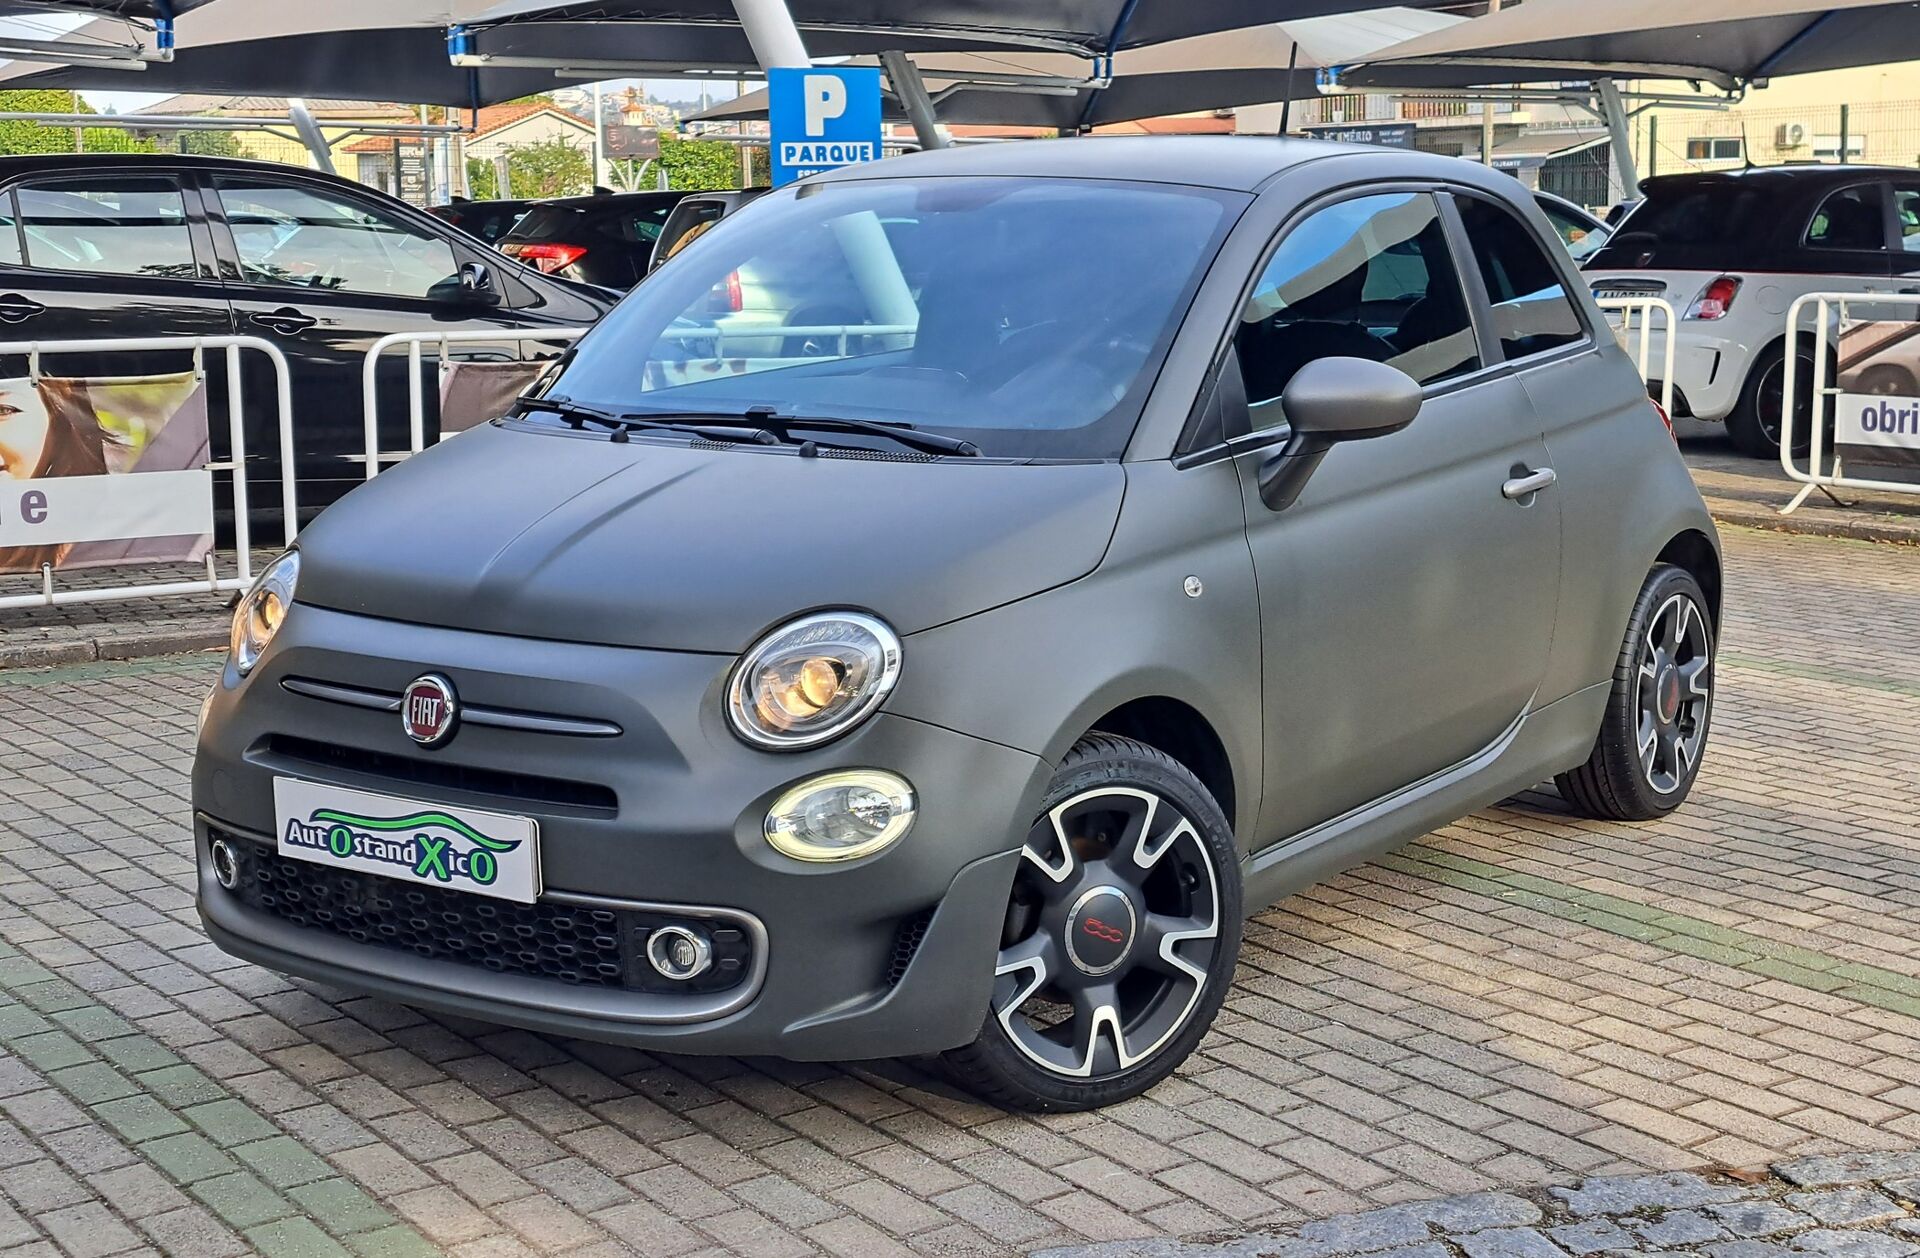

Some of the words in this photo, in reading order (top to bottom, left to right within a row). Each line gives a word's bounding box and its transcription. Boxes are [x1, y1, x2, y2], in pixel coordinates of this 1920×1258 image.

[803, 74, 847, 137] P
[784, 145, 870, 162] PARQUE
[411, 695, 441, 727] FIAT
